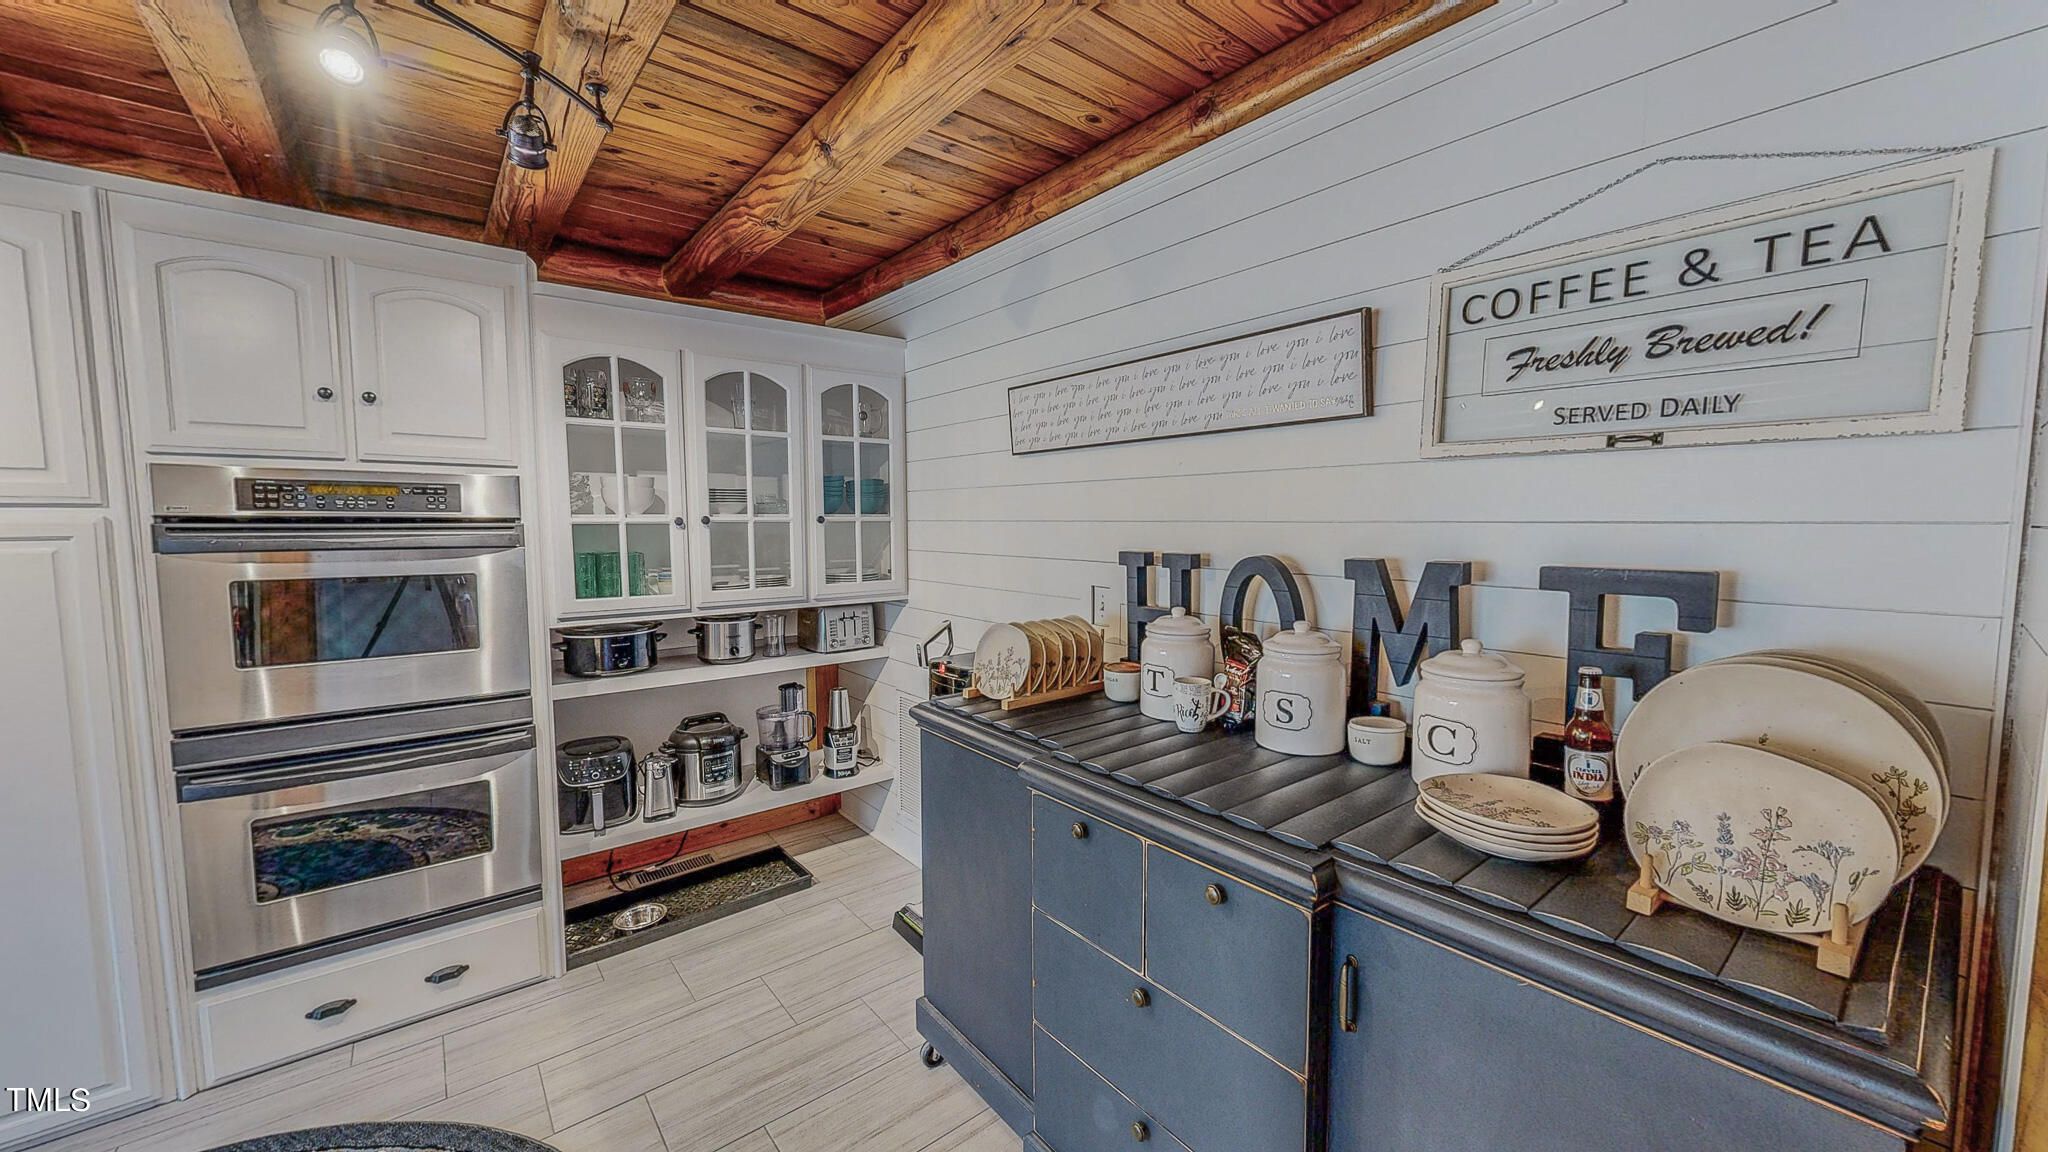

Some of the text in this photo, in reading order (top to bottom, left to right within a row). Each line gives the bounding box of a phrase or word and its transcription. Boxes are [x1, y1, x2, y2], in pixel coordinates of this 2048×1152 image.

[1462, 215, 1892, 325] COFFEE & TEA
[1142, 365, 1160, 380] love
[1163, 364, 1181, 381] you
[1196, 354, 1215, 370] love
[1220, 352, 1240, 371] you
[1257, 341, 1279, 357] love
[1286, 338, 1309, 359] you
[1329, 325, 1356, 343] love
[1505, 303, 1834, 382] Freshly Brewed!
[1149, 385, 1166, 402] you
[1179, 376, 1197, 391] love
[1202, 375, 1221, 393] you
[1236, 365, 1256, 381] love
[1263, 364, 1284, 385] you
[1302, 352, 1328, 369] love
[1333, 350, 1359, 371] you
[1144, 400, 1160, 414] love
[1166, 400, 1183, 416] you
[1197, 391, 1216, 406] love
[1222, 391, 1242, 409] you
[1259, 380, 1281, 397] love
[1288, 380, 1310, 399] you
[1330, 371, 1358, 386] love
[1553, 393, 1742, 426] SERVED DAILY
[1151, 420, 1168, 435] you
[1181, 412, 1198, 426] love
[1204, 412, 1223, 429] you
[1118, 550, 1720, 718] HOME
[1147, 669, 1165, 692] T
[1276, 698, 1293, 724] S
[1353, 737, 1371, 745] SALT
[1428, 725, 1456, 757] C
[1572, 770, 1605, 782] INDIA
